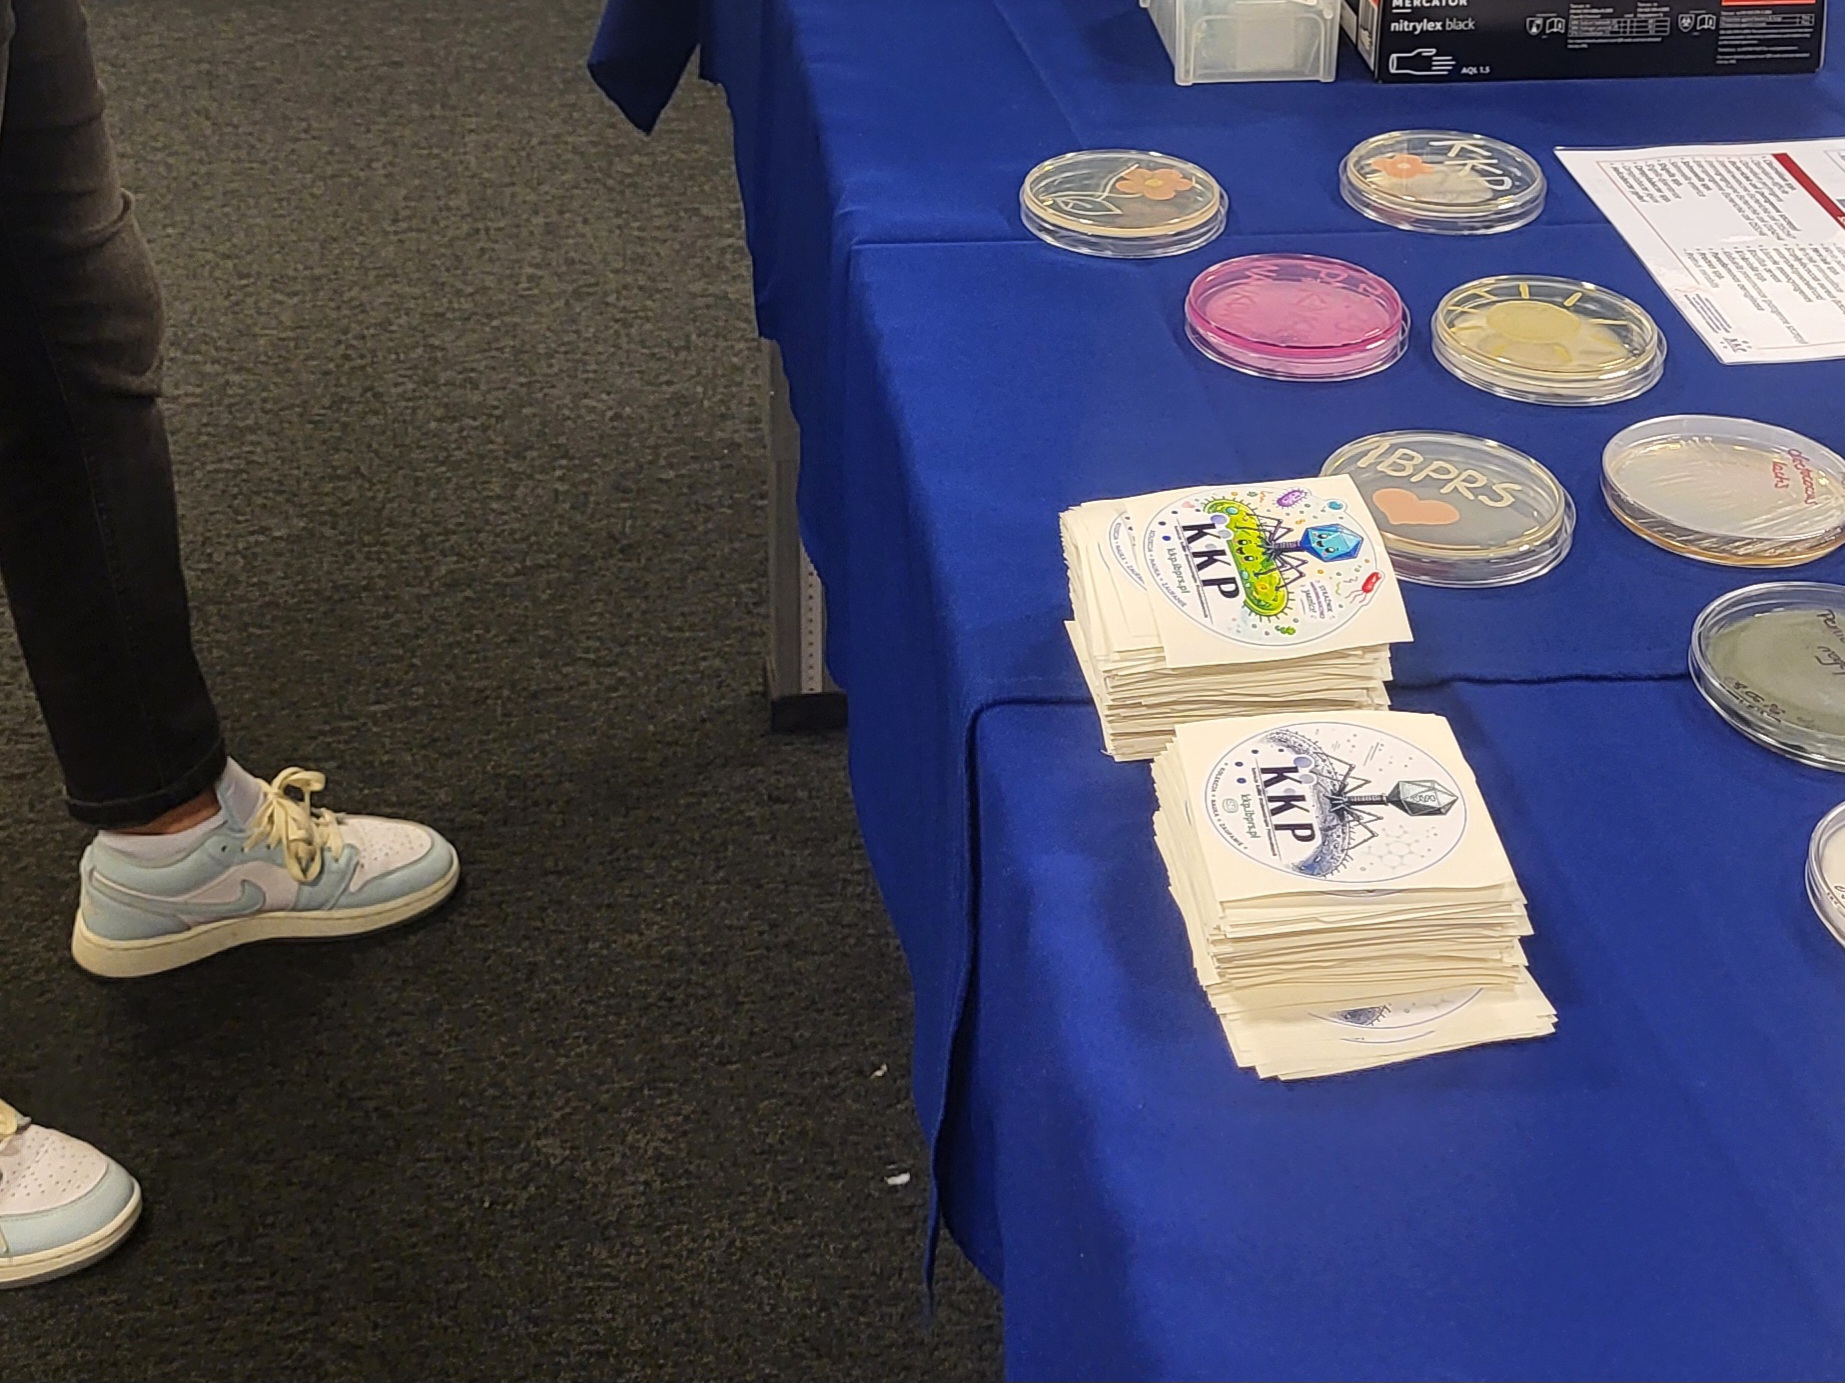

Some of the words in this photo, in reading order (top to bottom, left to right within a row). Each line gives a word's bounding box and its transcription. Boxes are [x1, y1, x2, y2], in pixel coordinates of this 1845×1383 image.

[1390, 19, 1443, 34] nitrylex
[1445, 17, 1476, 31] black
[1461, 67, 1478, 75] AQL
[1479, 66, 1490, 74] 1.5
[1167, 548, 1190, 593] kkp.ibprs.pl
[1183, 523, 1239, 598] KKP
[1240, 794, 1260, 838] kkp.ibprs.pl
[1261, 767, 1315, 841] KKP
